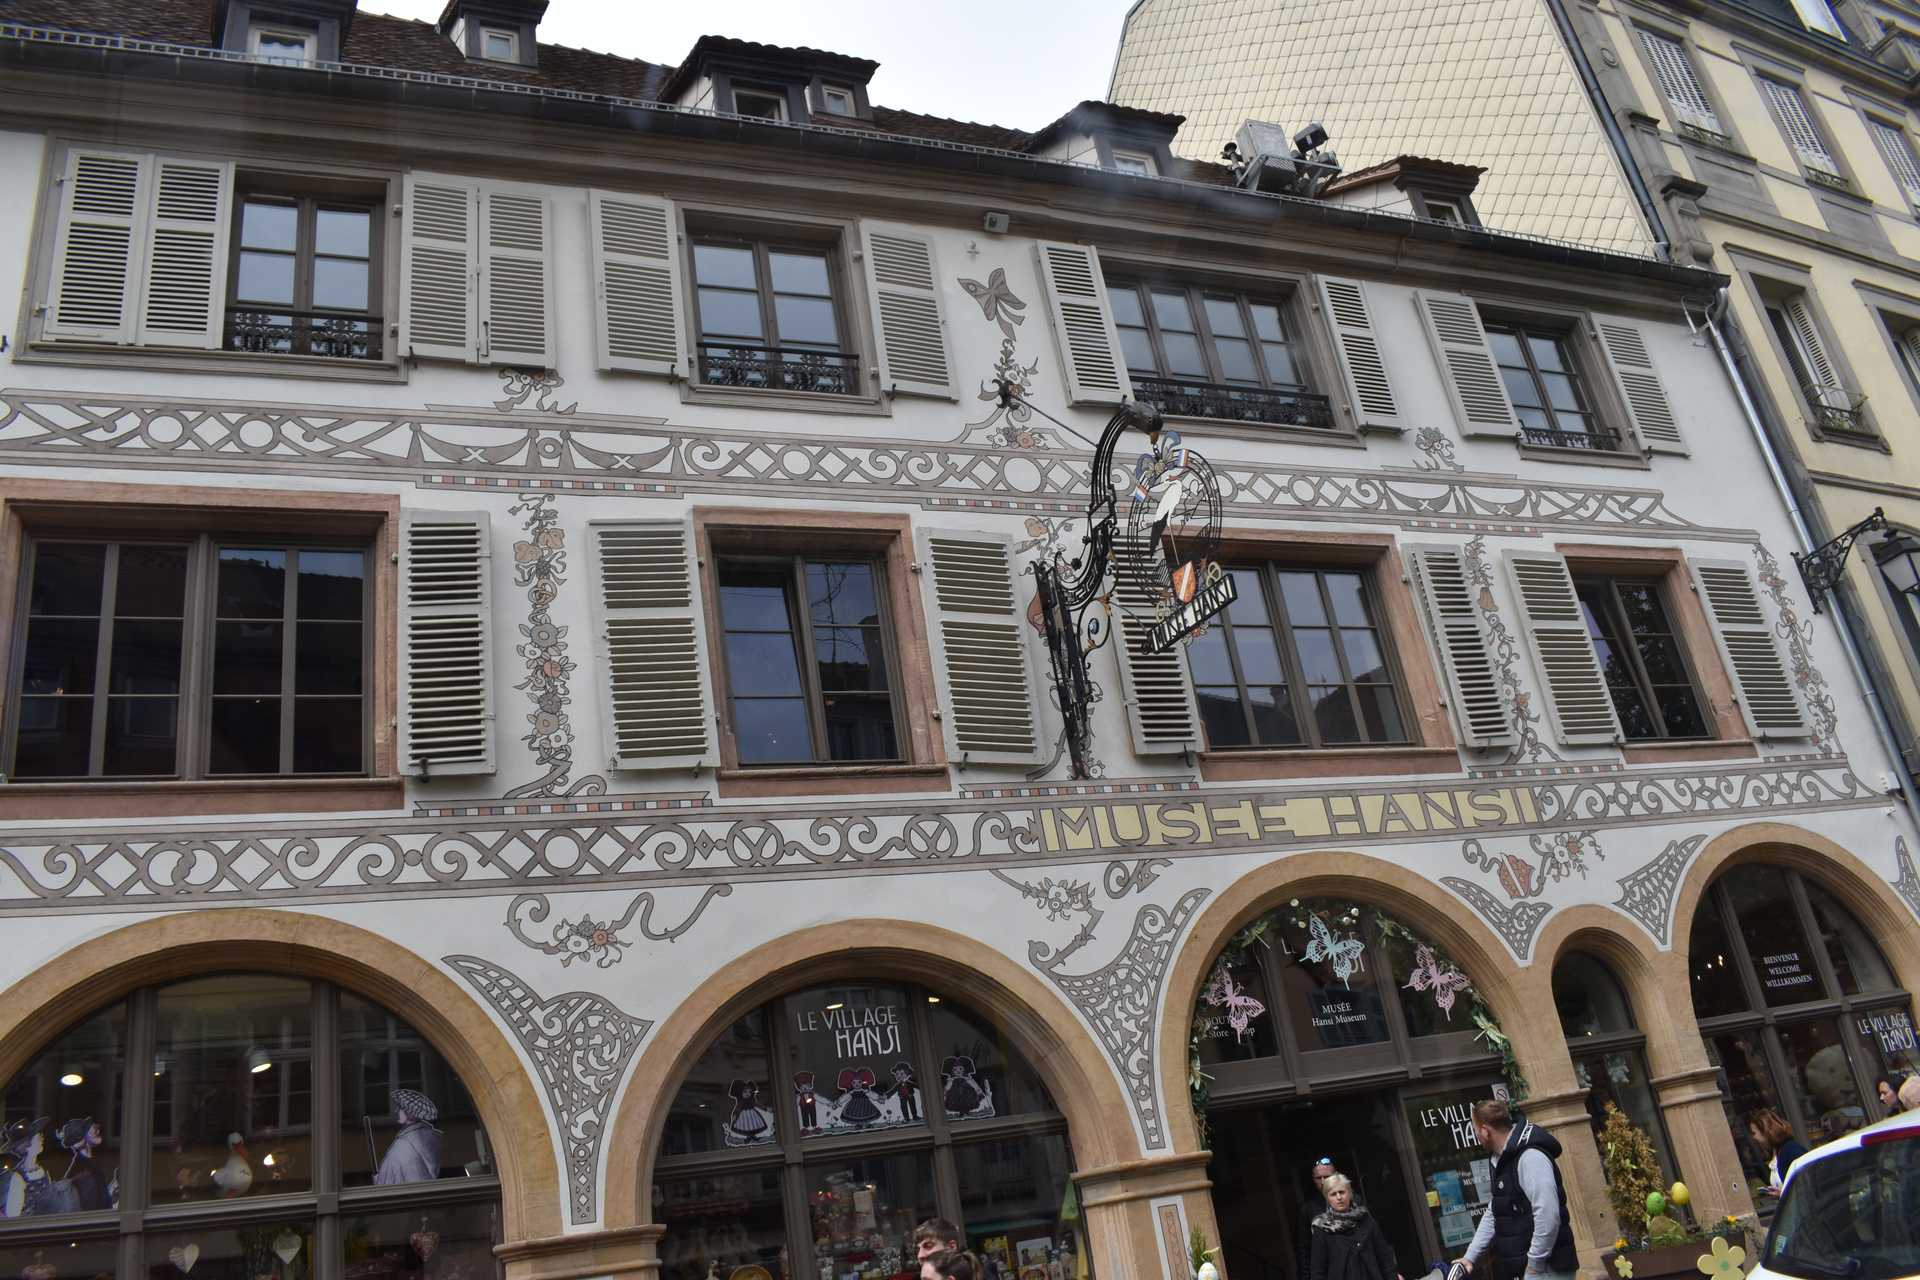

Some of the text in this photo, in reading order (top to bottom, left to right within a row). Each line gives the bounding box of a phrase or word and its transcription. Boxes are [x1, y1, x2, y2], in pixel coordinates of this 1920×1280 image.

[1192, 575, 1232, 623] HANSI
[1051, 786, 1526, 852] MUSEE HANSI
[1763, 952, 1799, 965] BIENVENUE
[1768, 964, 1800, 975] WELCOME
[797, 1005, 899, 1031] LE VILLAGE
[1312, 1014, 1367, 1027] Hansi Museum
[1857, 1012, 1910, 1035] LE VILLAGE
[835, 1025, 901, 1058] HANSI
[1879, 1027, 1917, 1053] HANSI
[1420, 1102, 1475, 1128] LE VILLA
